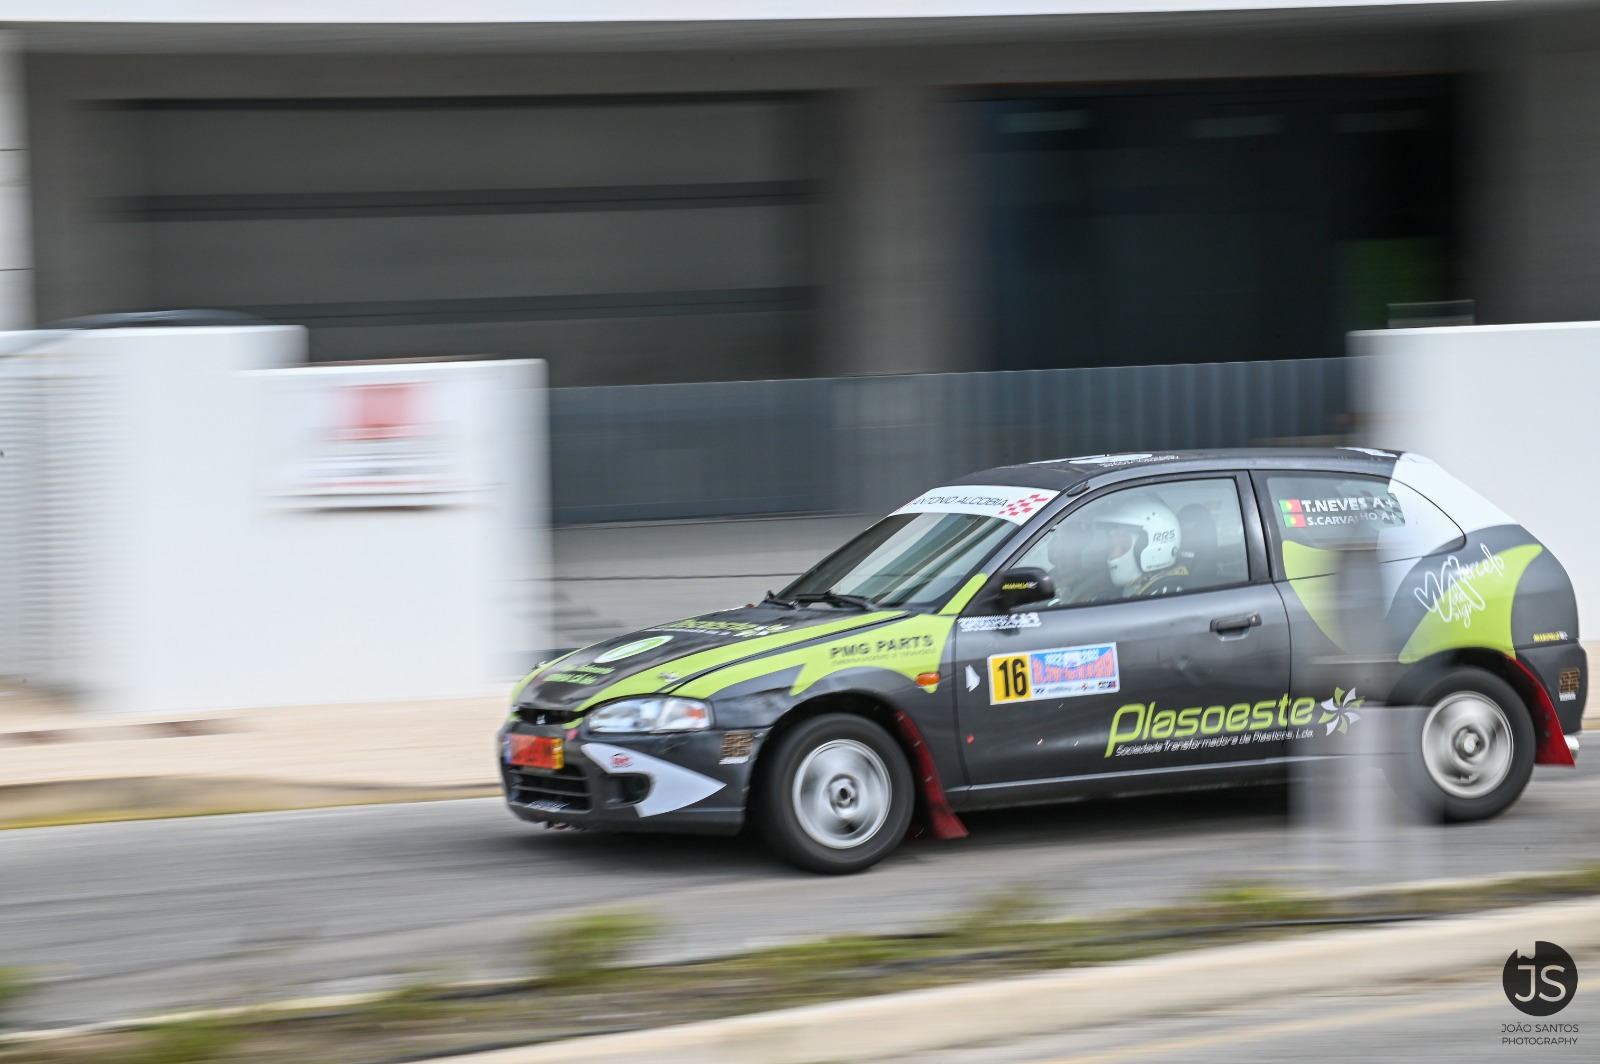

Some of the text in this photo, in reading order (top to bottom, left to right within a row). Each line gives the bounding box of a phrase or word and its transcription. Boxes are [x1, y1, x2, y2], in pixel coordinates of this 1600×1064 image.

[1301, 497, 1368, 513] T.NEVES
[1153, 529, 1176, 543] RRS
[830, 642, 870, 660] PMG
[876, 634, 933, 654] PARTS
[998, 658, 1027, 698] 16
[1115, 741, 1162, 757] Sociedade
[1163, 734, 1238, 752] Transformadora
[1239, 732, 1251, 745] de
